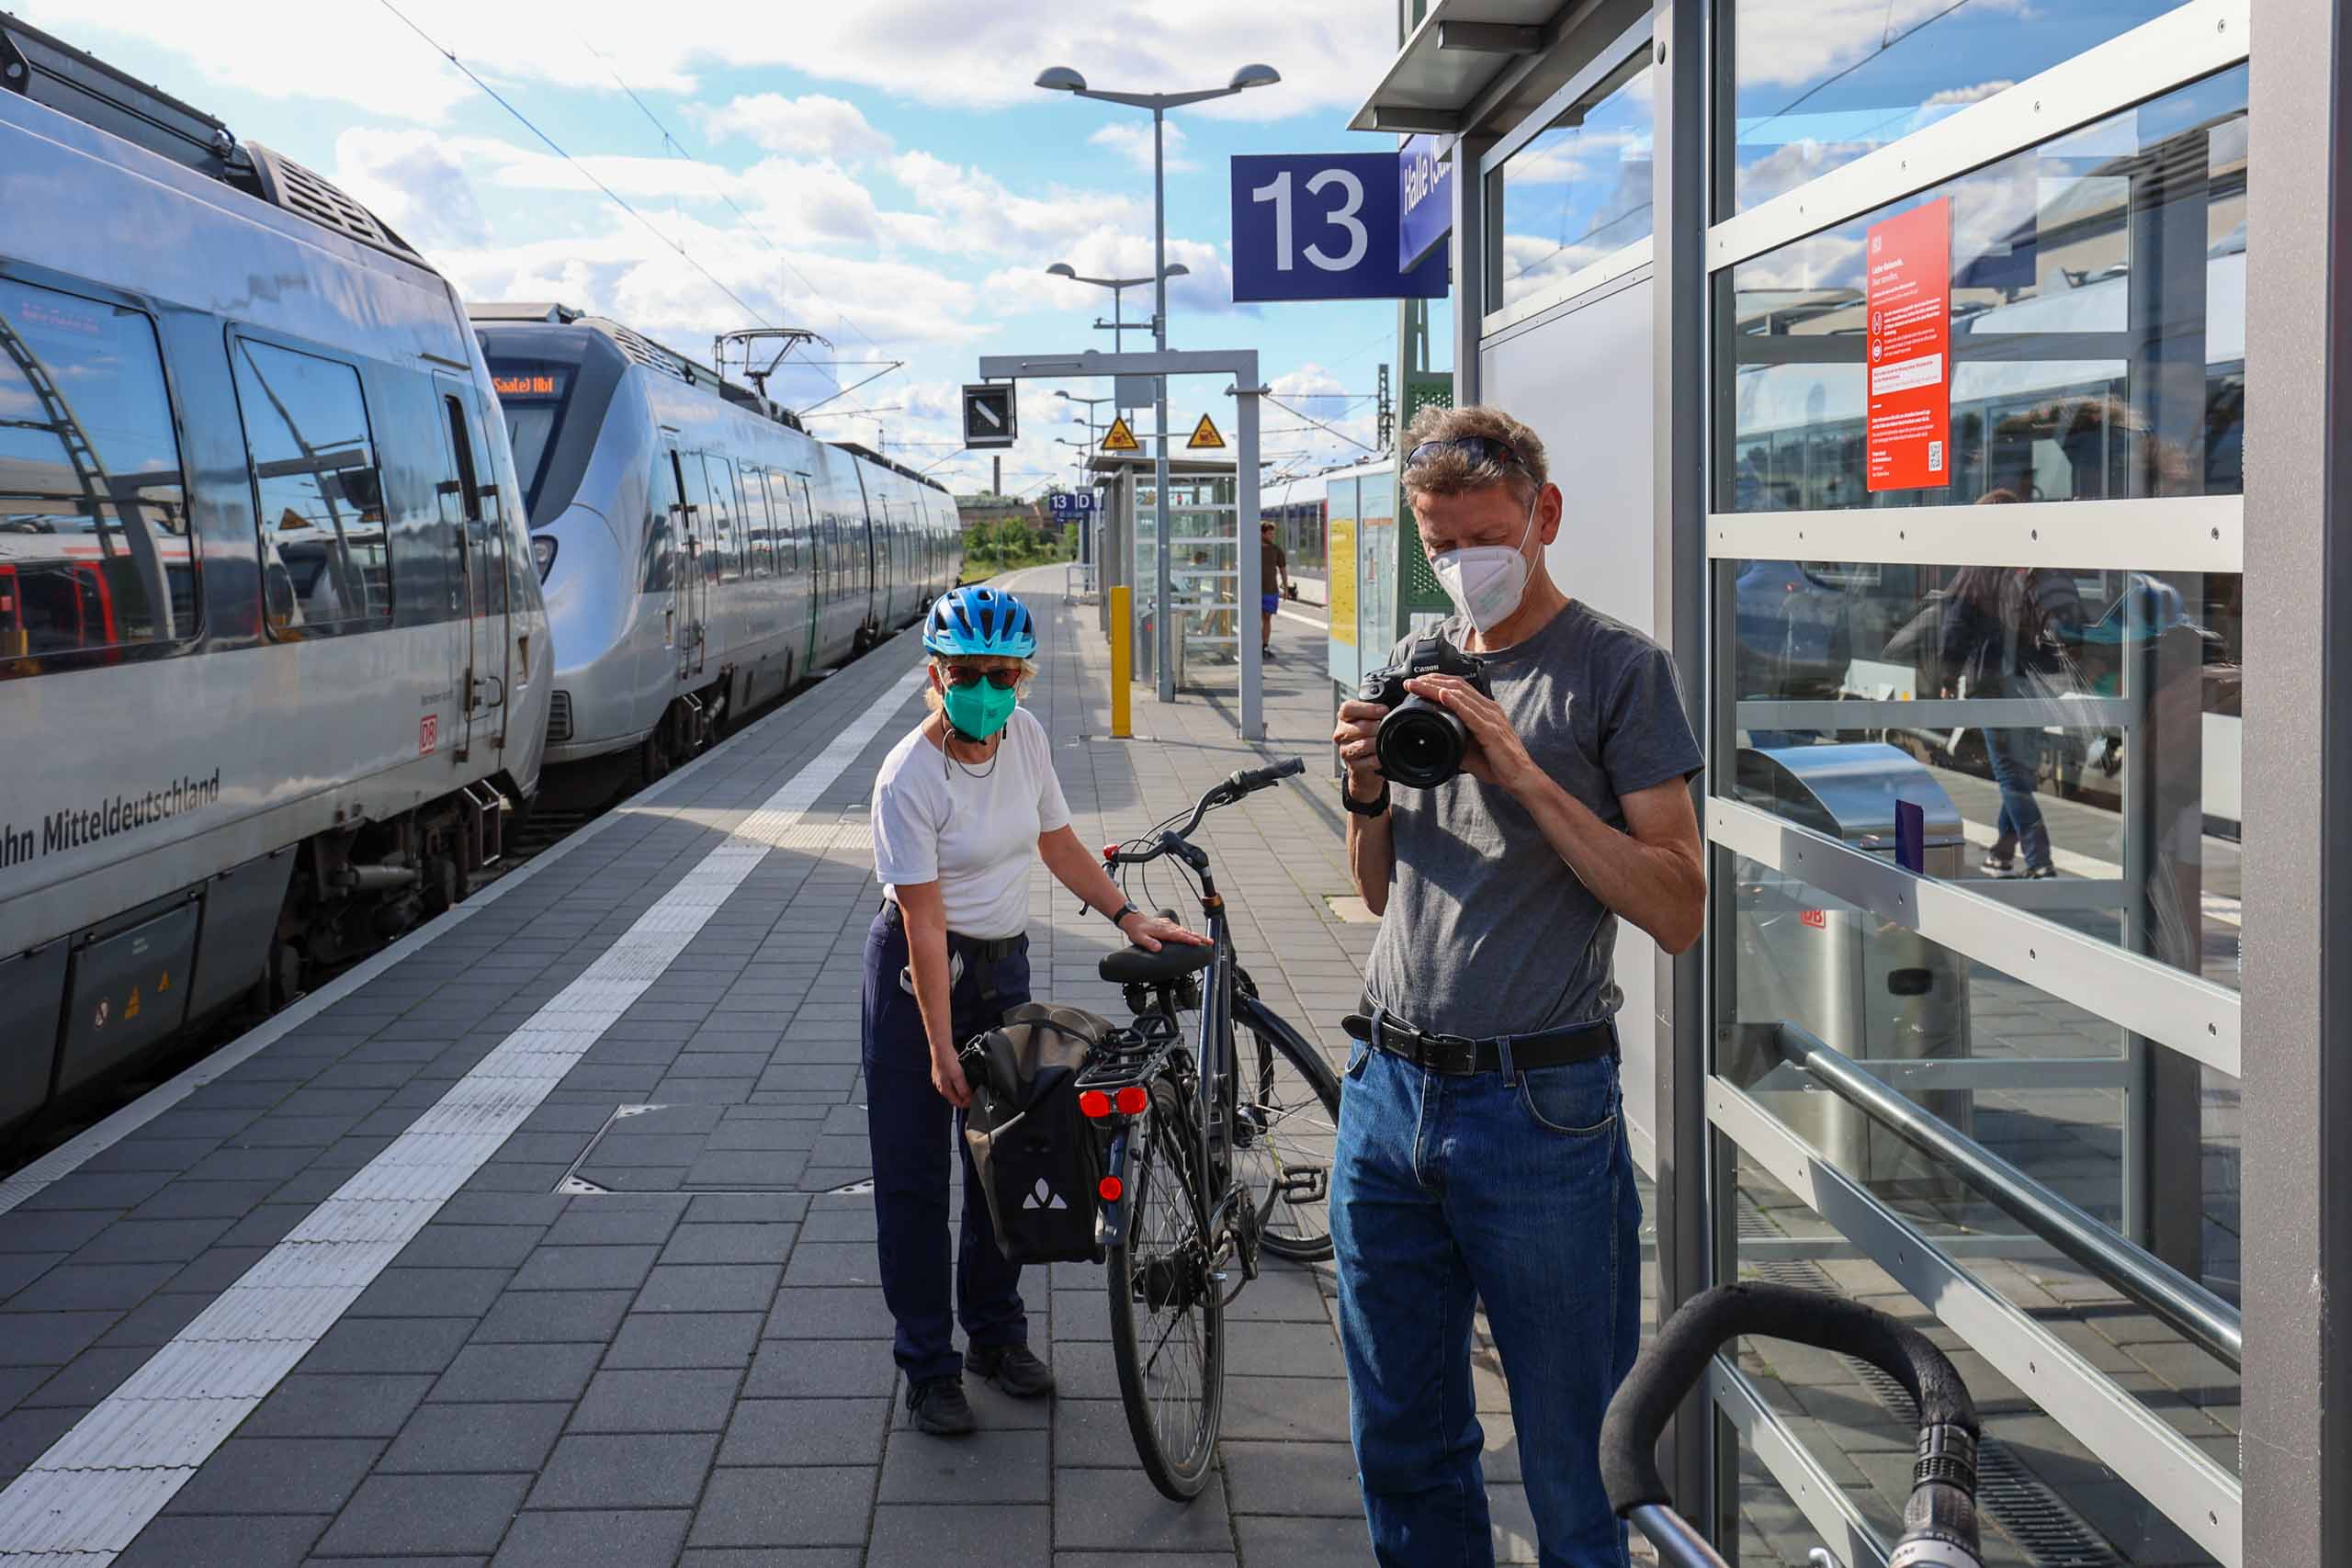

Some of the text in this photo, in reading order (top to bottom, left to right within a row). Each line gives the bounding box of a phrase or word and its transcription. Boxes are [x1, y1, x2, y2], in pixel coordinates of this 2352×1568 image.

[1405, 151, 1428, 216] Halle
[1252, 168, 1368, 272] 13
[1051, 494, 1090, 509] 13 D
[1413, 664, 1440, 673] Canon
[422, 719, 435, 749] DB
[42, 767, 220, 856] Mitteldeutschland
